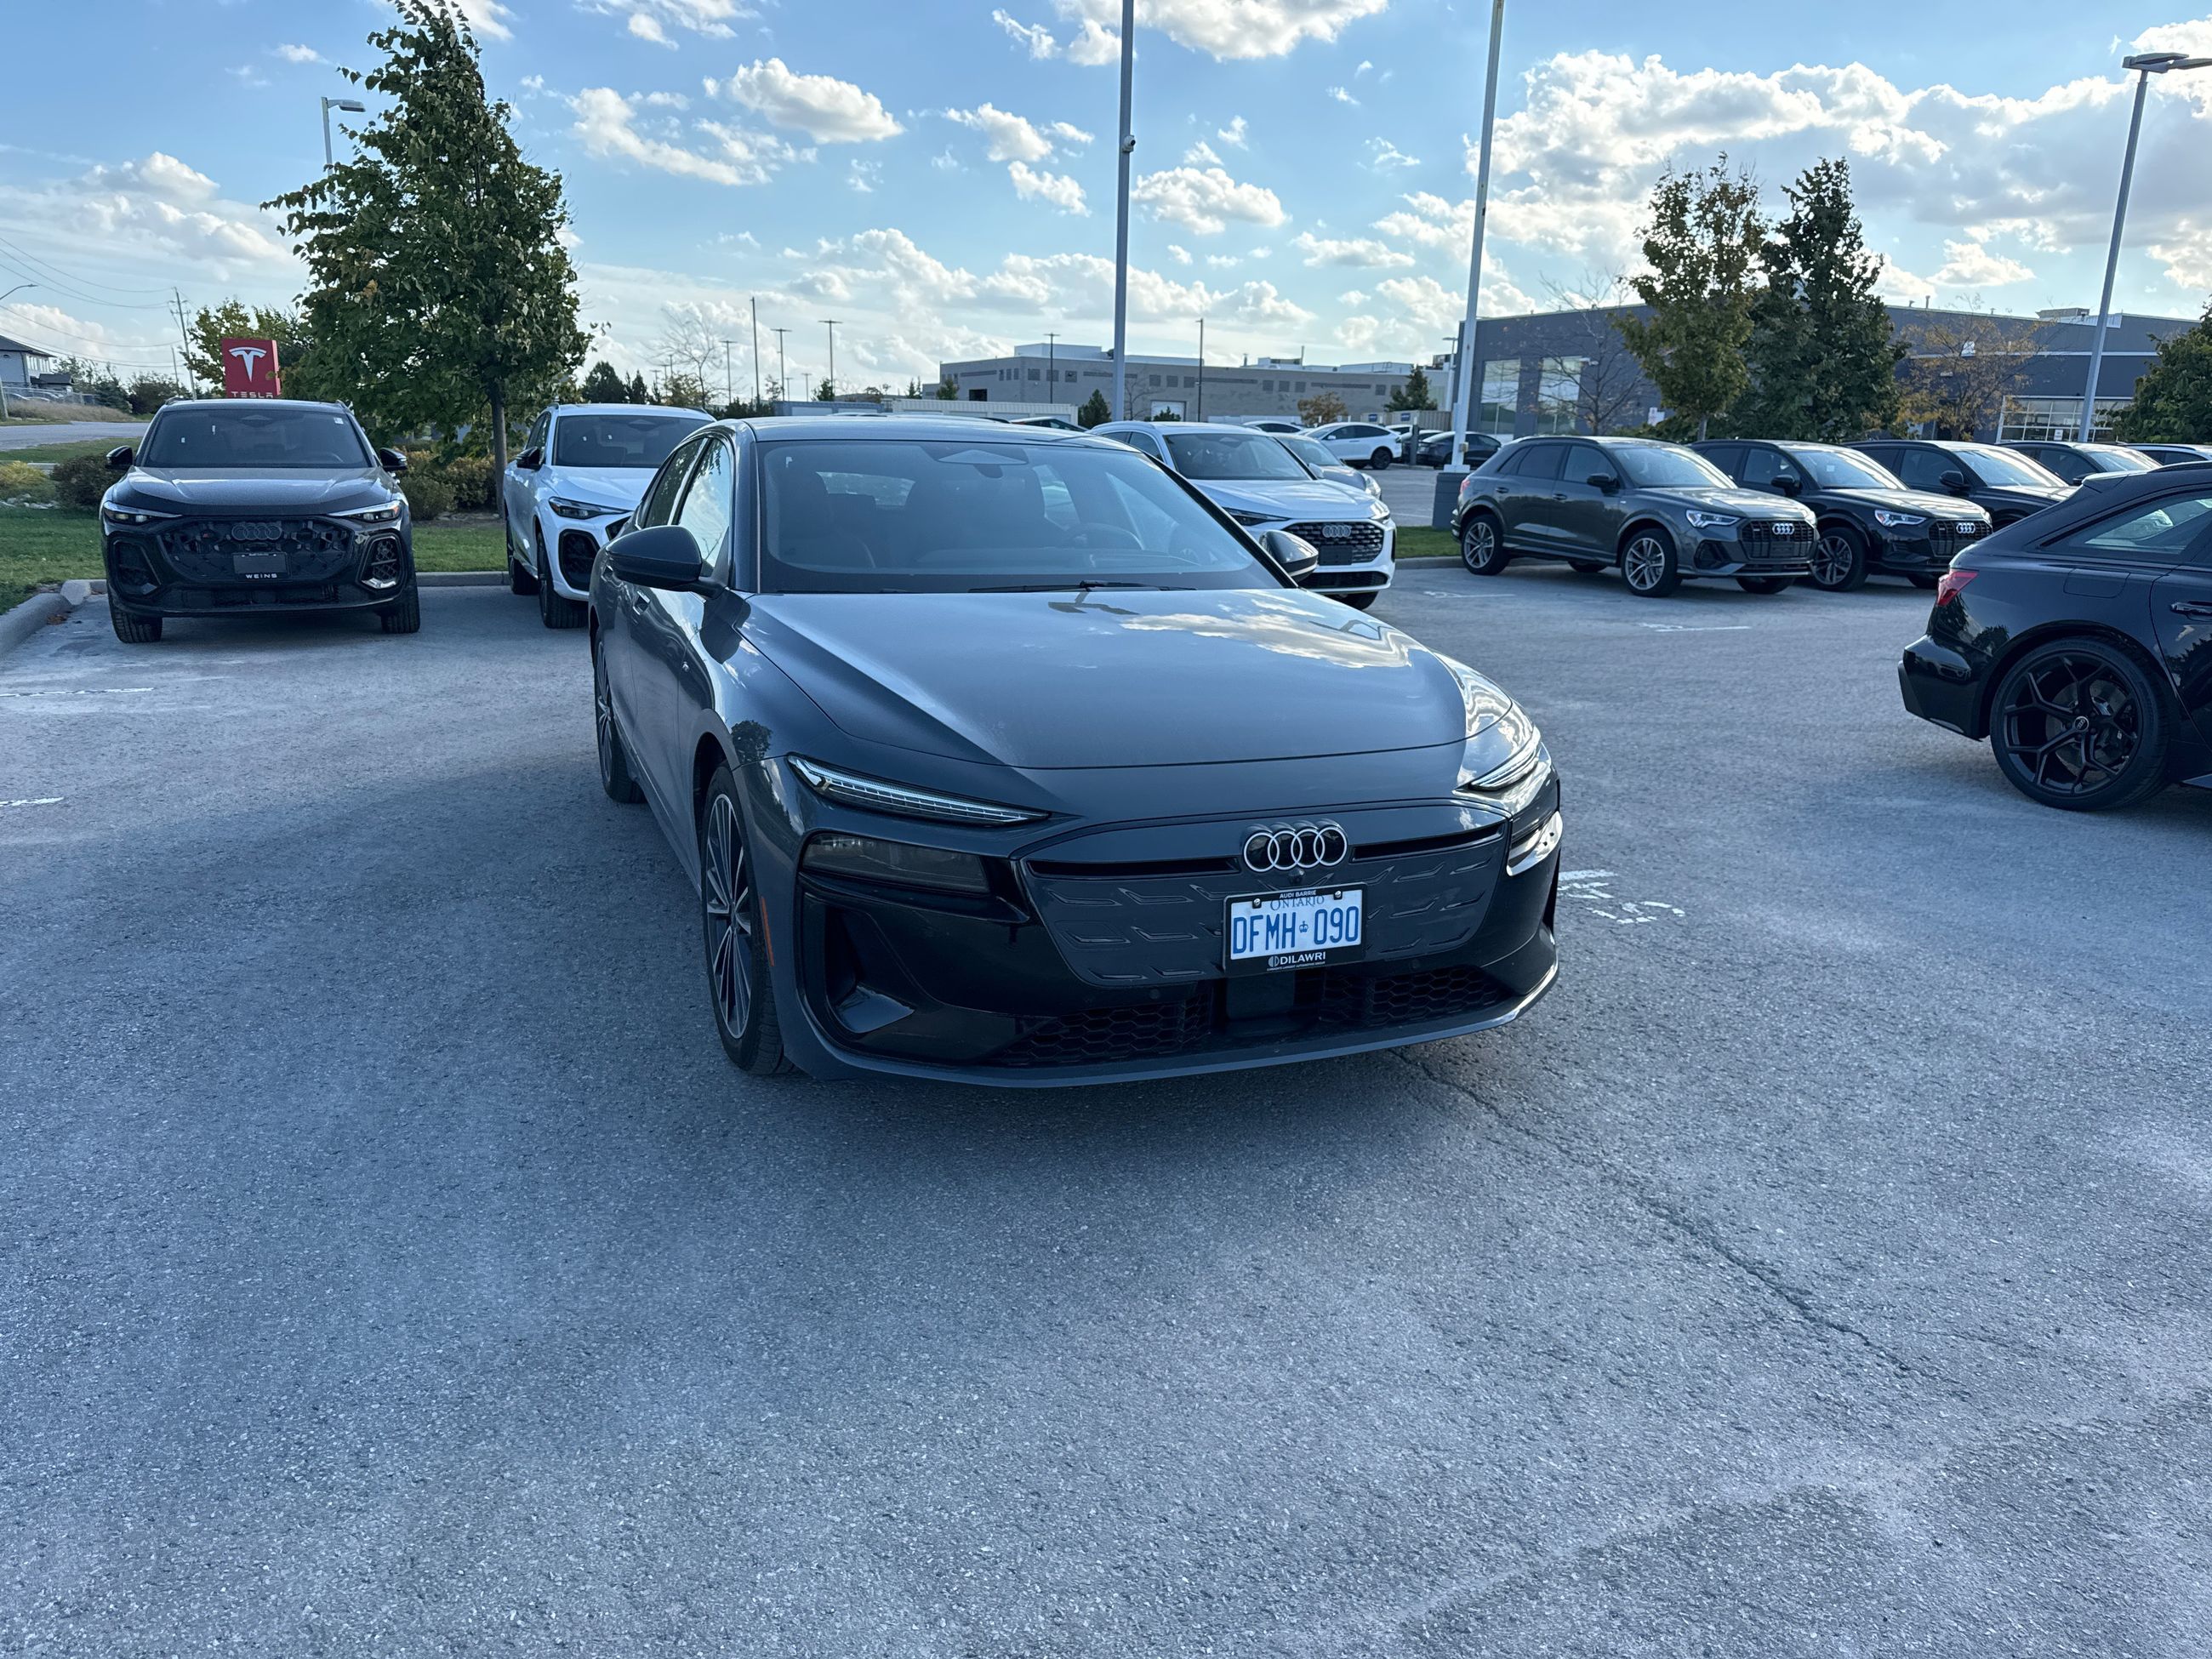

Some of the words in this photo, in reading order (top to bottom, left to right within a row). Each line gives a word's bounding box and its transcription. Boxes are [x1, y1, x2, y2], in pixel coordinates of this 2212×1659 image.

[231, 391, 274, 399] TESLA
[1270, 896, 1325, 910] ONTARIO
[1233, 911, 1297, 954] DFMH
[1314, 906, 1359, 944] 090
[1280, 951, 1326, 966] DILAWRI
